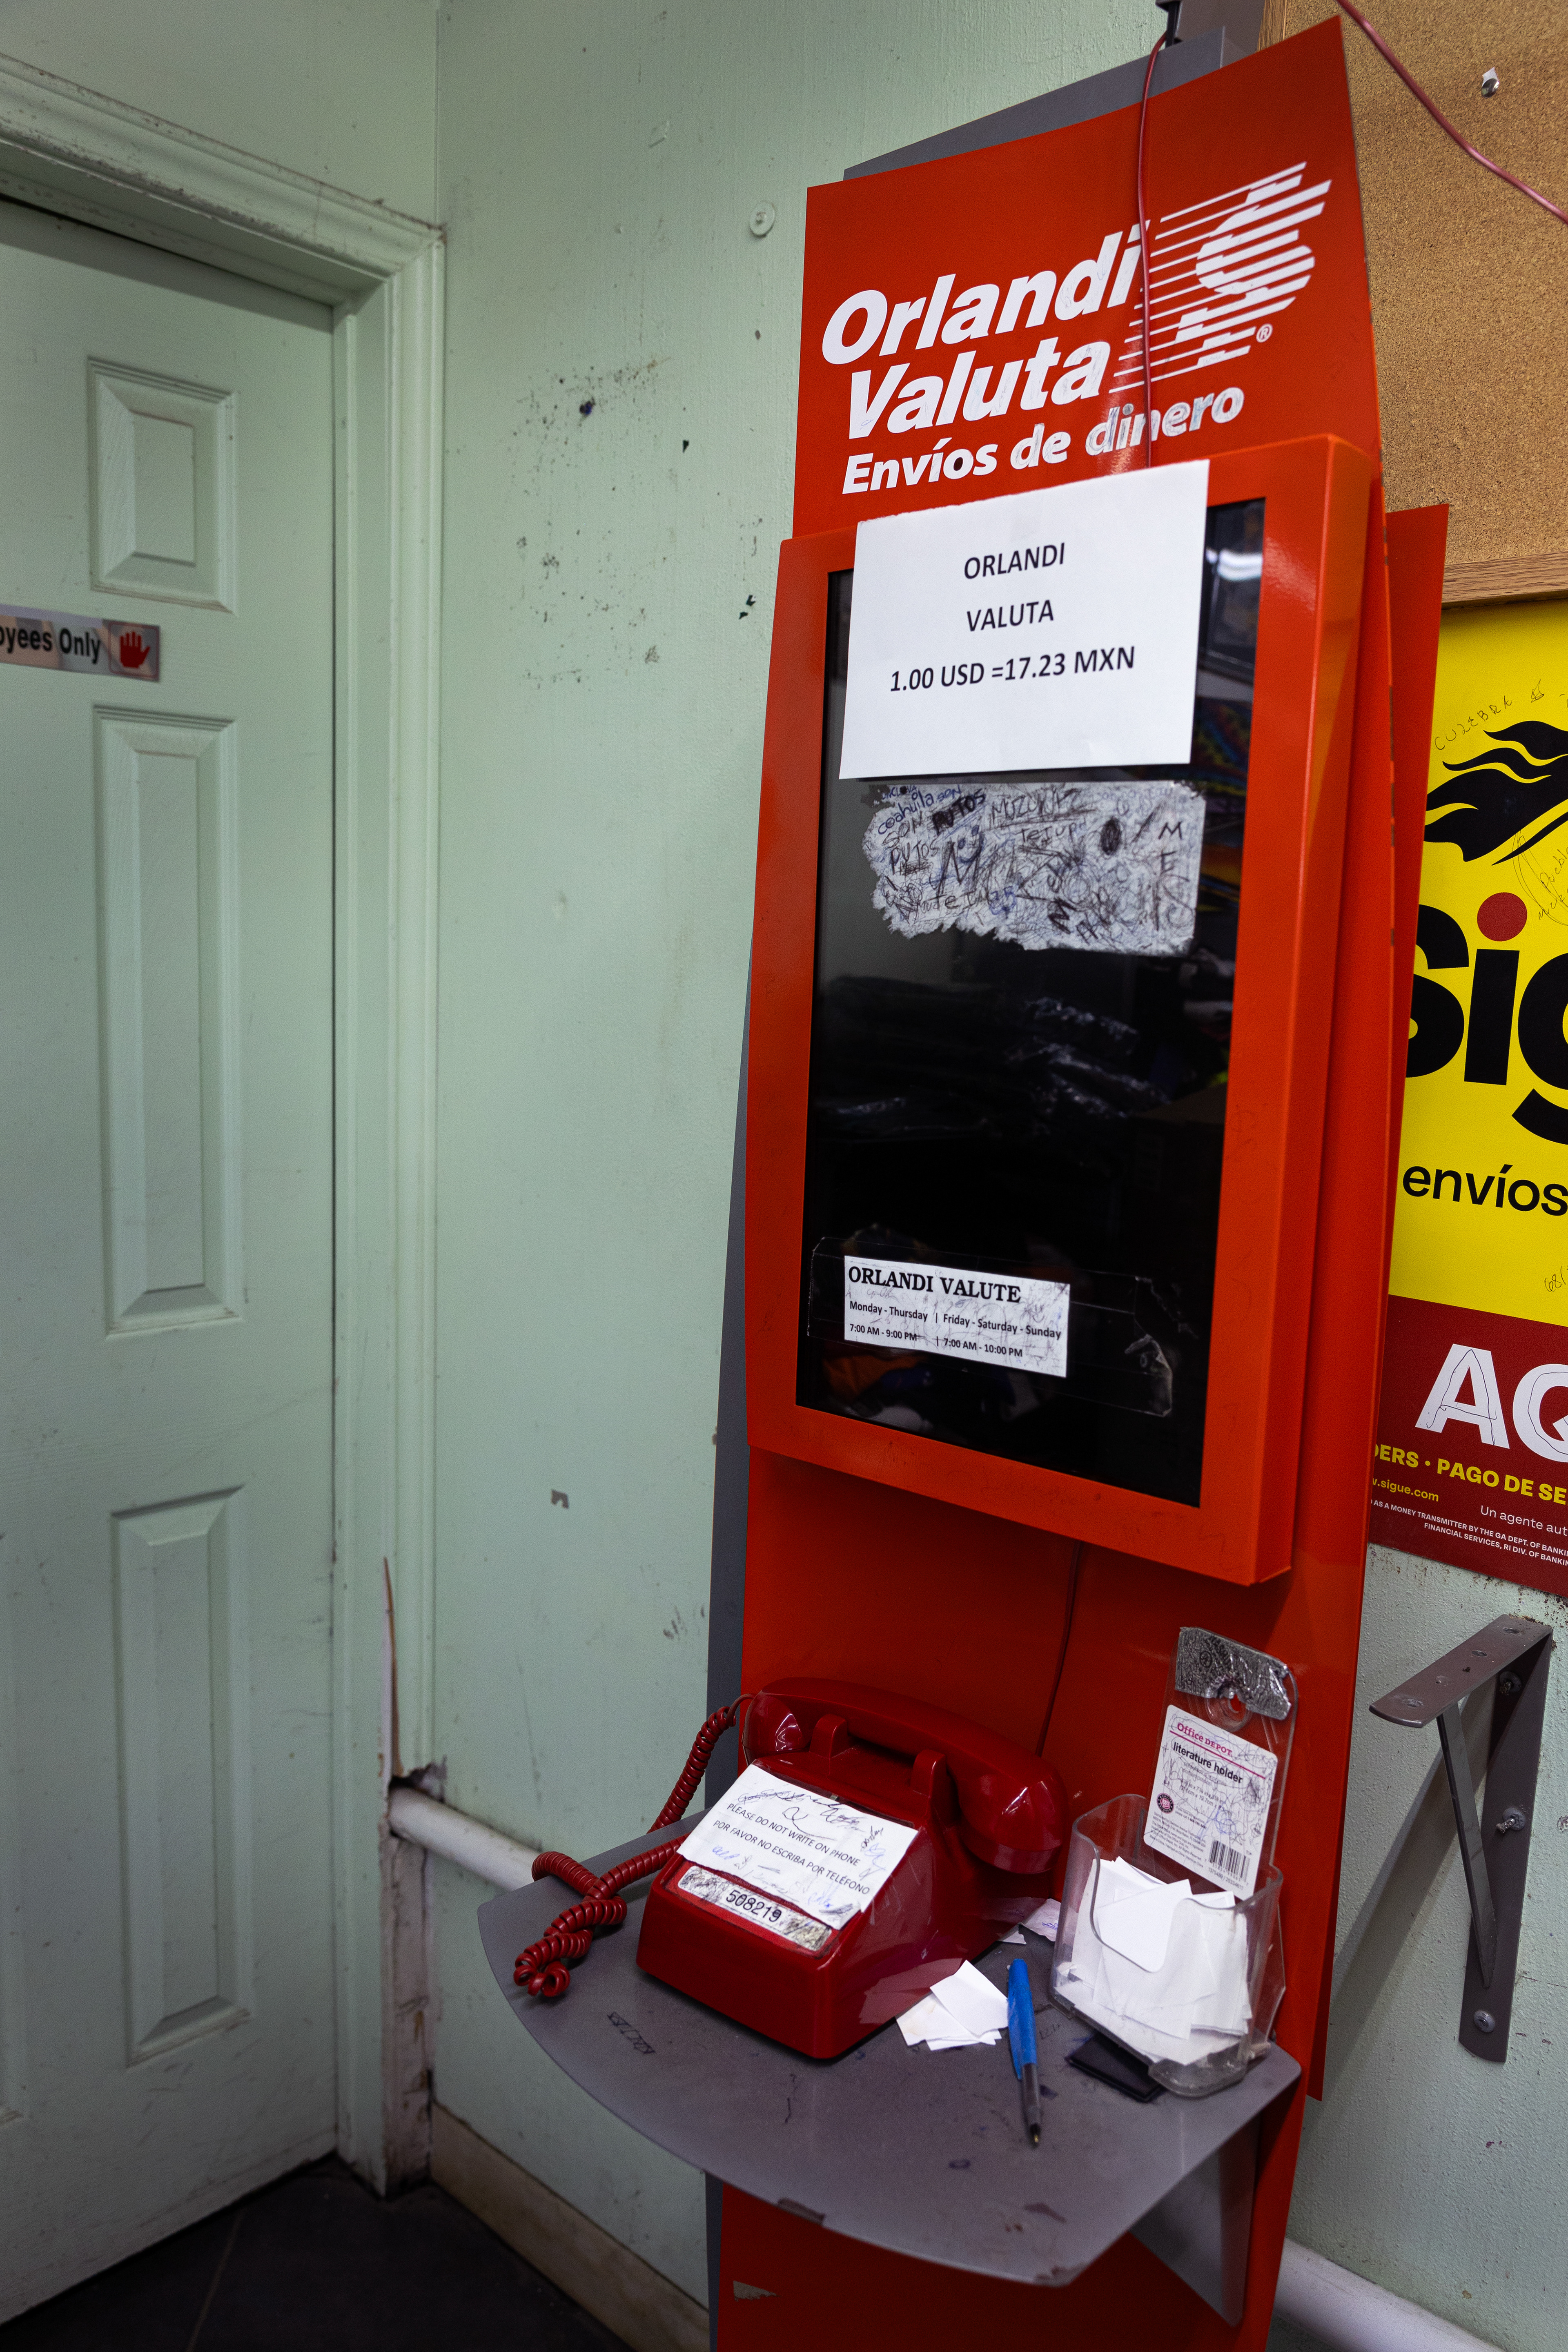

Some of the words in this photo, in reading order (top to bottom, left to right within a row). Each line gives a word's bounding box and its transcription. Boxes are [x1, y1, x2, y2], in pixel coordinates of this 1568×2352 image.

[822, 220, 1150, 365] Orlandi
[849, 337, 1110, 439] Valuta
[842, 435, 998, 494] Envíos
[1011, 423, 1071, 470] de
[1085, 387, 1244, 457] dinero
[964, 542, 1065, 580] ORLANDI
[966, 599, 1054, 633] VALUTA
[59, 628, 101, 664] Only
[890, 668, 934, 692] 1.00
[940, 663, 984, 687] USD
[991, 653, 1065, 681] =17.23
[1074, 646, 1136, 674] MXN
[1402, 1164, 1568, 1217] envíos
[849, 1266, 933, 1292] ORLANDI
[940, 1277, 1021, 1303] VALUTE
[850, 1301, 882, 1315] Monday
[889, 1306, 928, 1322] Thursday
[944, 1314, 970, 1327] Friday
[978, 1319, 1017, 1334] Saturday
[1026, 1325, 1061, 1340] Sunday
[850, 1323, 865, 1333] 7:00
[867, 1326, 880, 1336] AM
[886, 1330, 902, 1339] 9:00
[904, 1332, 917, 1341] PM
[944, 1338, 961, 1348] 7:00
[963, 1341, 977, 1350] AM
[984, 1344, 1007, 1354] 10:00
[1009, 1348, 1022, 1357] PM
[1415, 1343, 1568, 1463] AQ
[1437, 1458, 1499, 1487] PAGO
[1504, 1474, 1534, 1497] DE
[1538, 1483, 1568, 1506] SE
[1391, 1504, 1416, 1516] MONEY
[1417, 1511, 1467, 1530] TRANSMITTER
[1480, 1528, 1494, 1537] THE
[1508, 1535, 1528, 1546] DEPT.
[1424, 1522, 1462, 1538] FINANCIAL
[1464, 1533, 1502, 1549] SERVICES,
[1512, 1546, 1527, 1555] DIV.
[1481, 1505, 1496, 1518] Un
[1500, 1512, 1543, 1530] agente
[1546, 1524, 1568, 1536] aut
[1177, 1722, 1204, 1742] Office
[1205, 1738, 1232, 1757] DEPOT
[1173, 1742, 1212, 1768] literature
[1214, 1762, 1243, 1784] holder
[725, 1802, 757, 1822] PLEASE
[753, 1815, 770, 1827] DO
[767, 1821, 789, 1835] NOT
[786, 1828, 817, 1847] WRITE
[813, 1841, 831, 1854] ON
[829, 1848, 861, 1867] PHONE
[712, 1820, 731, 1832] POR
[728, 1826, 758, 1844] FAVOR
[756, 1839, 773, 1851] NO
[770, 1846, 807, 1866] ESCRIBA
[804, 1861, 826, 1875] POR
[824, 1868, 873, 1896] TELÉFONO
[726, 1889, 783, 1922] 508219
